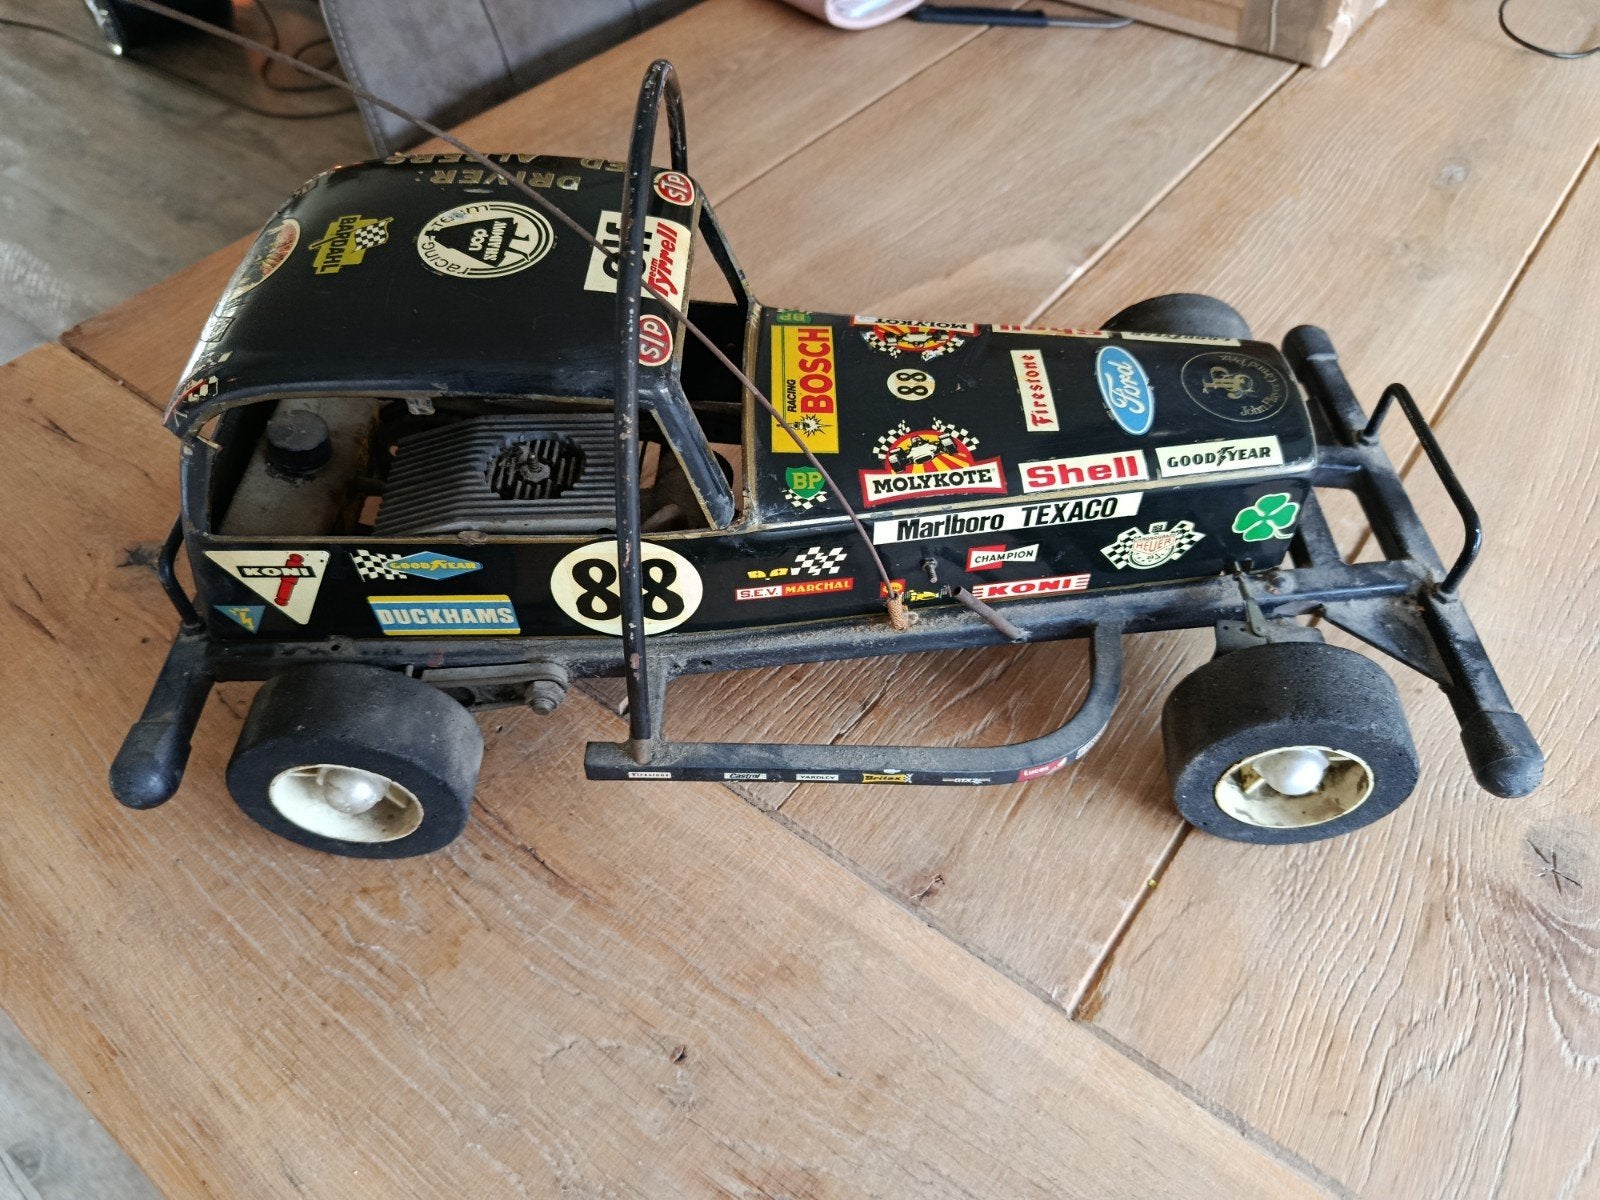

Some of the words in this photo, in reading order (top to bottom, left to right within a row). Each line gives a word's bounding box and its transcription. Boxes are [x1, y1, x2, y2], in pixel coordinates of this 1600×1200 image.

[660, 173, 690, 202] STP
[320, 216, 356, 273] BARDAHL
[647, 221, 679, 298] Tyrrell
[797, 327, 835, 414] BOSCH
[787, 378, 797, 413] RACING
[896, 372, 929, 396] 88
[1021, 353, 1054, 428] Firestone
[1104, 360, 1145, 415] Ford
[1166, 445, 1272, 468] GOODYEAR
[791, 472, 823, 490] BP
[872, 468, 993, 494] MOLYKOTE
[1026, 455, 1139, 488] Shell
[896, 513, 1005, 541] Marlboro
[1021, 497, 1119, 527] TEXACO
[974, 549, 1034, 563] CHAMPION
[1135, 537, 1172, 553] HEUER
[242, 567, 311, 577] KONI
[389, 559, 477, 572] GOODYEAR
[571, 558, 685, 620] 88
[740, 586, 779, 599] S.E.V.
[785, 580, 851, 595] MARCHAL
[987, 578, 1073, 597] KONI
[379, 607, 516, 625] DUCKHAMS
